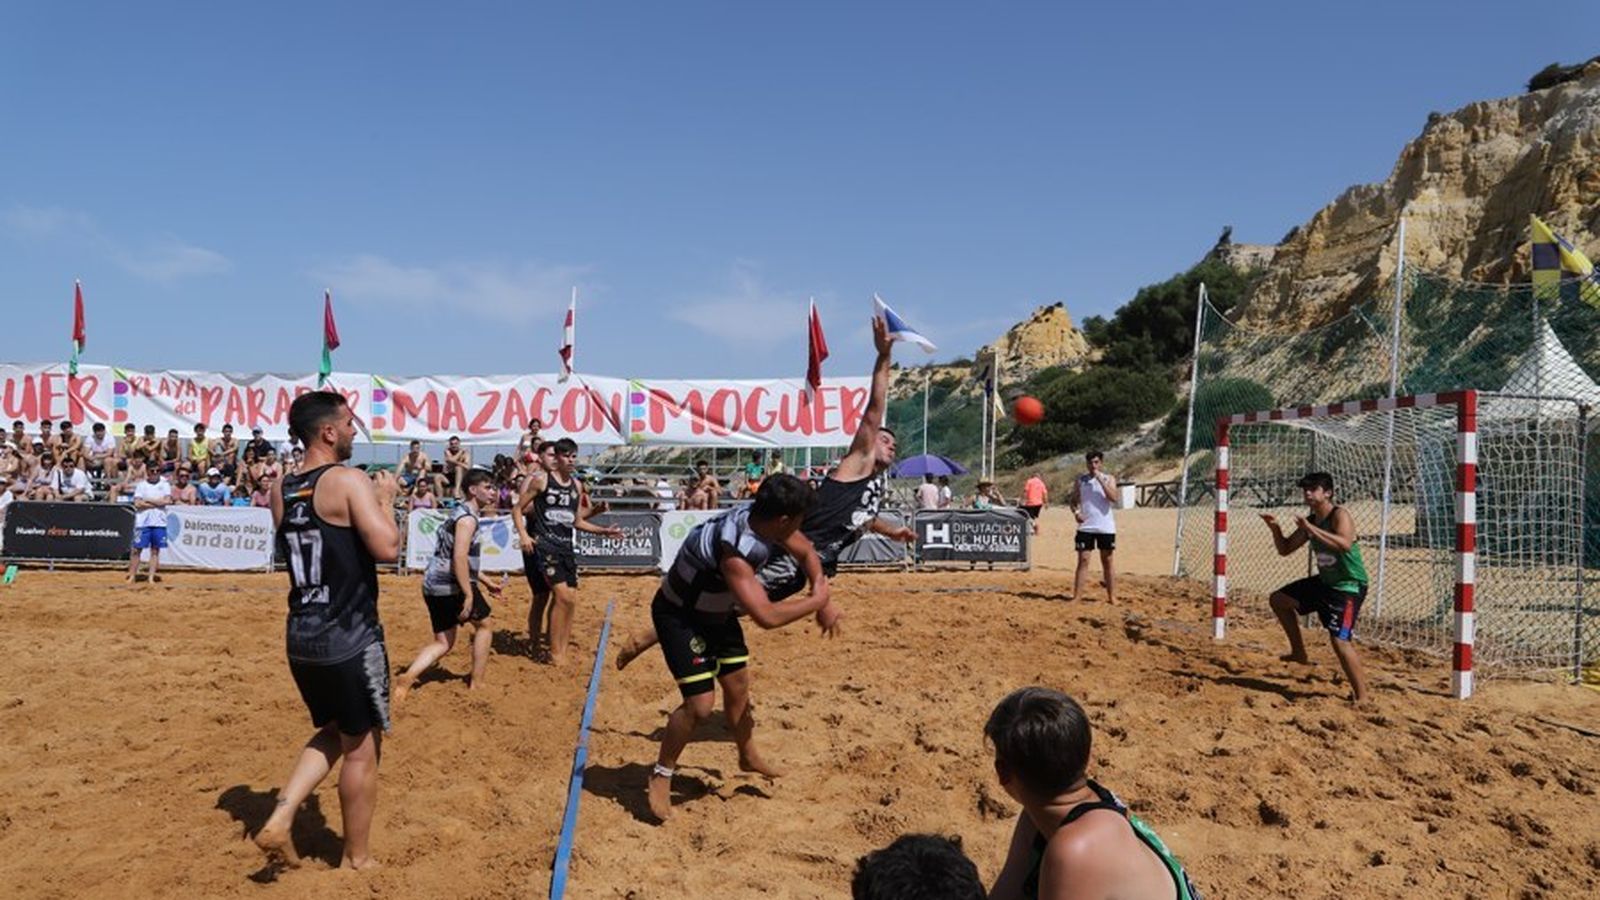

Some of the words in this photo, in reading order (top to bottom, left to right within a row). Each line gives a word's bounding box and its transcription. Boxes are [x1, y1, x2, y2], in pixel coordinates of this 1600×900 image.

[128, 374, 198, 399] PLAYA
[174, 400, 196, 416] del
[200, 385, 360, 428] PARAR
[649, 386, 868, 436] MOGUER
[184, 519, 240, 533] balonmano
[952, 521, 1021, 534] DIPUTACIÓN
[182, 533, 267, 551] andaluz
[580, 538, 596, 549] DE
[602, 538, 652, 549] HUELVA
[953, 534, 967, 544] DE
[973, 535, 1020, 545] HUELVA
[285, 529, 323, 587] 17
